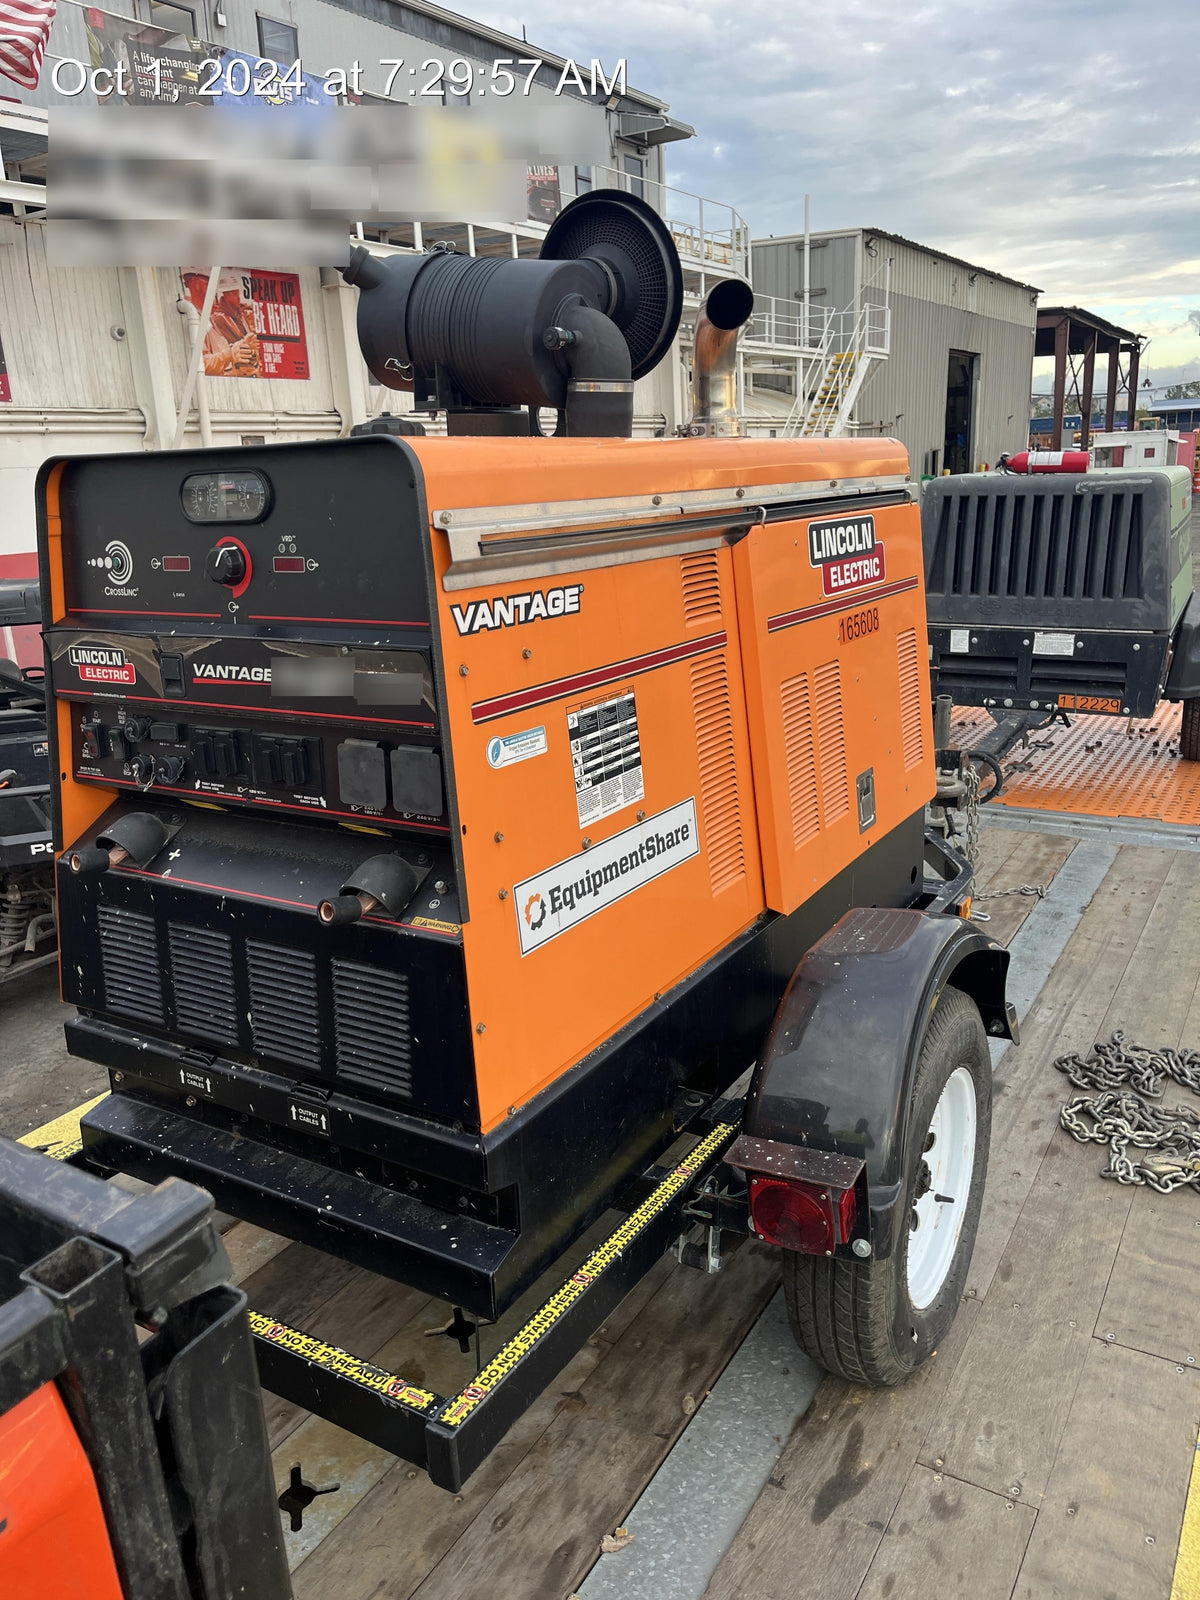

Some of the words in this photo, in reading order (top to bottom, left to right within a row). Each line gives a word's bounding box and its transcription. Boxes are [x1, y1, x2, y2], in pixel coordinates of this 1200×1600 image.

[134, 62, 174, 78] incnt
[137, 76, 155, 88] can
[188, 85, 198, 95] at
[140, 88, 156, 101] any
[241, 276, 277, 302] SPEAK
[280, 281, 295, 304] UP
[252, 301, 266, 334] BE
[267, 303, 300, 337] HEARD
[812, 522, 873, 560] LINCOLN
[830, 556, 881, 588] ELECTRIC
[452, 586, 581, 635] VANTAGE
[839, 607, 880, 643] 165608
[72, 649, 123, 666] LINCOLN
[85, 667, 130, 681] ELECTRIC
[193, 663, 272, 682] VANTAGE
[1061, 696, 1120, 712] 112229
[548, 821, 691, 914] EquipmentShare
[185, 1072, 204, 1083] OUTPUT
[186, 1078, 205, 1089] CABLES
[298, 1108, 318, 1119] OUTPUT
[299, 1115, 319, 1126] CABLES
[686, 1156, 700, 1167] NO
[697, 1147, 708, 1156] SE
[706, 1130, 725, 1146] PARE
[586, 1260, 601, 1273] NE
[600, 1243, 618, 1260] PAS
[615, 1217, 644, 1242] TENEZ
[640, 1187, 672, 1217] DEBOUT
[670, 1176, 682, 1187] ICI
[250, 1318, 268, 1331] ICI
[281, 1332, 301, 1347] NO
[302, 1342, 321, 1355] SE
[321, 1350, 356, 1371] PARE
[480, 1369, 499, 1387] DO
[497, 1344, 521, 1368] NOT
[520, 1311, 555, 1344] STAND
[552, 1284, 580, 1310] HERE
